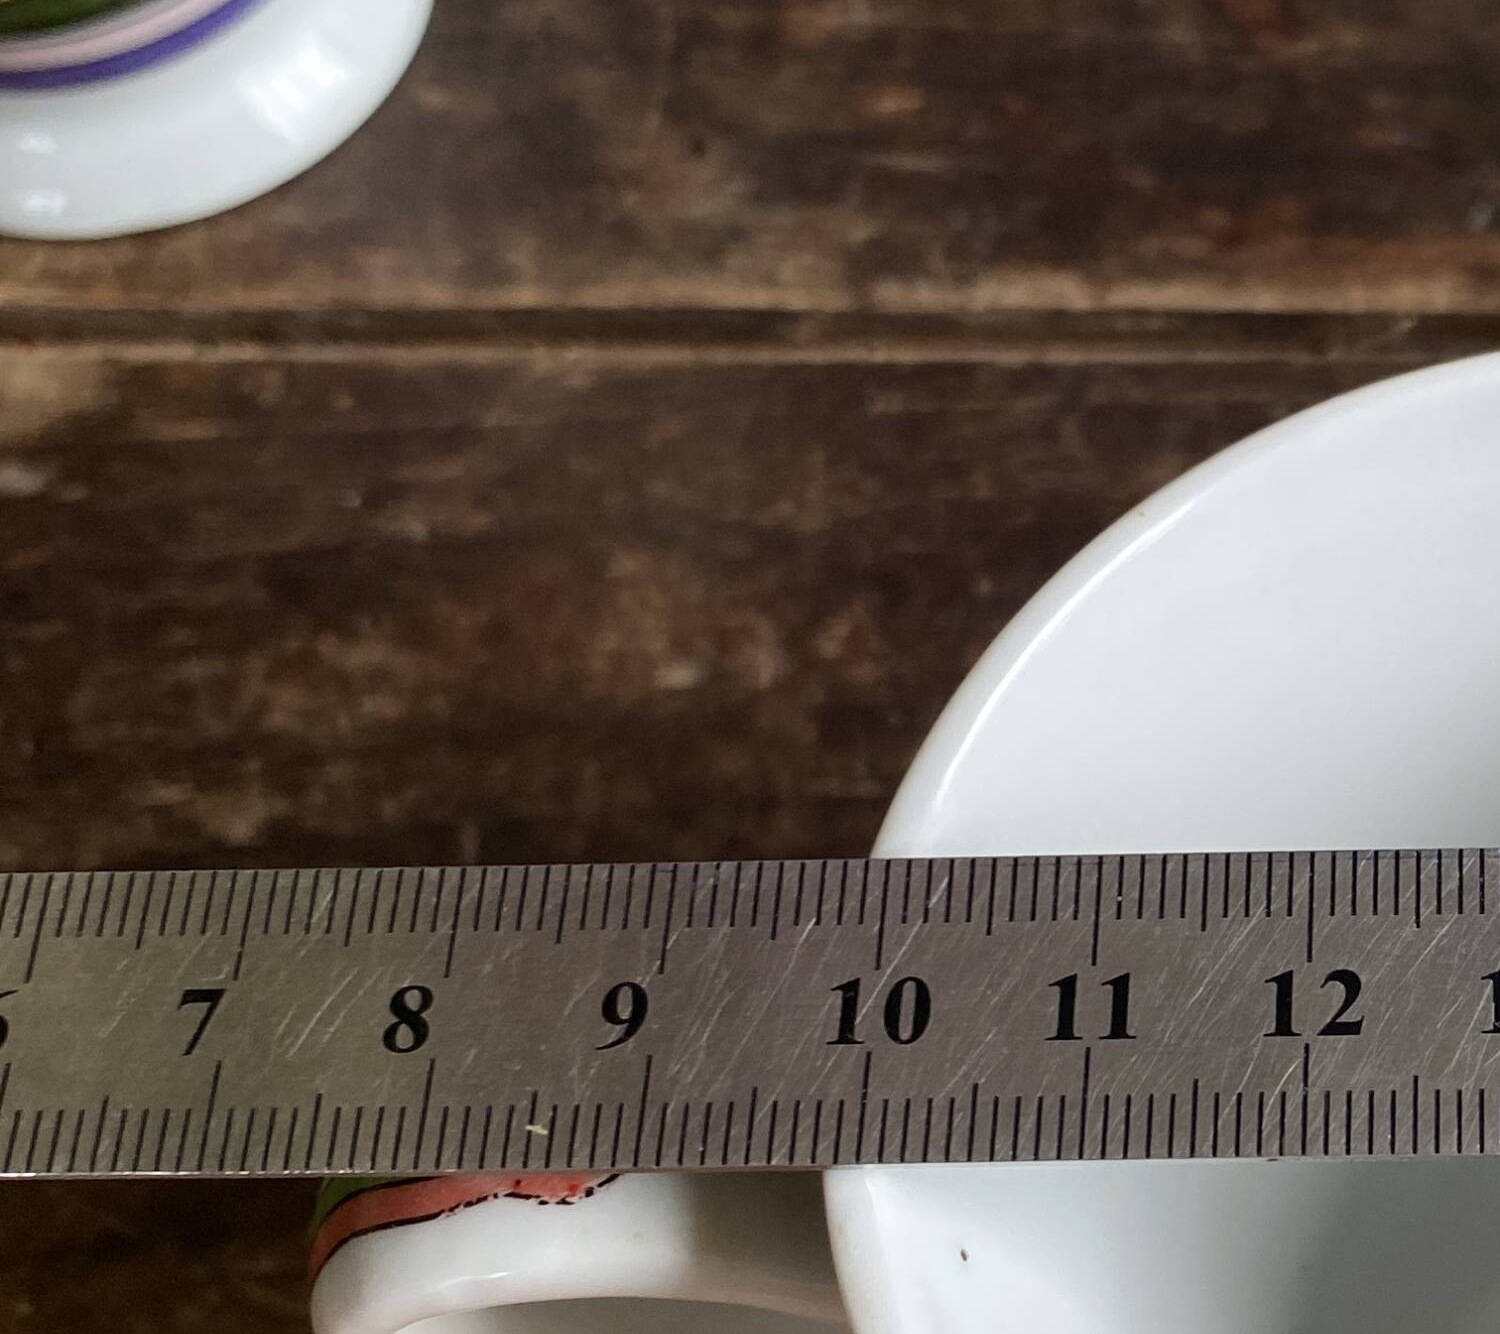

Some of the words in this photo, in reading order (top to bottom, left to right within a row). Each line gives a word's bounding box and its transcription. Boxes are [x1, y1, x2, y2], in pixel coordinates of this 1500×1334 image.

[178, 989, 227, 1056] 7
[383, 986, 433, 1053] 8
[595, 982, 648, 1050] 9
[826, 977, 931, 1045] 10
[1045, 972, 1136, 1040] 11
[1263, 969, 1364, 1037] 12
